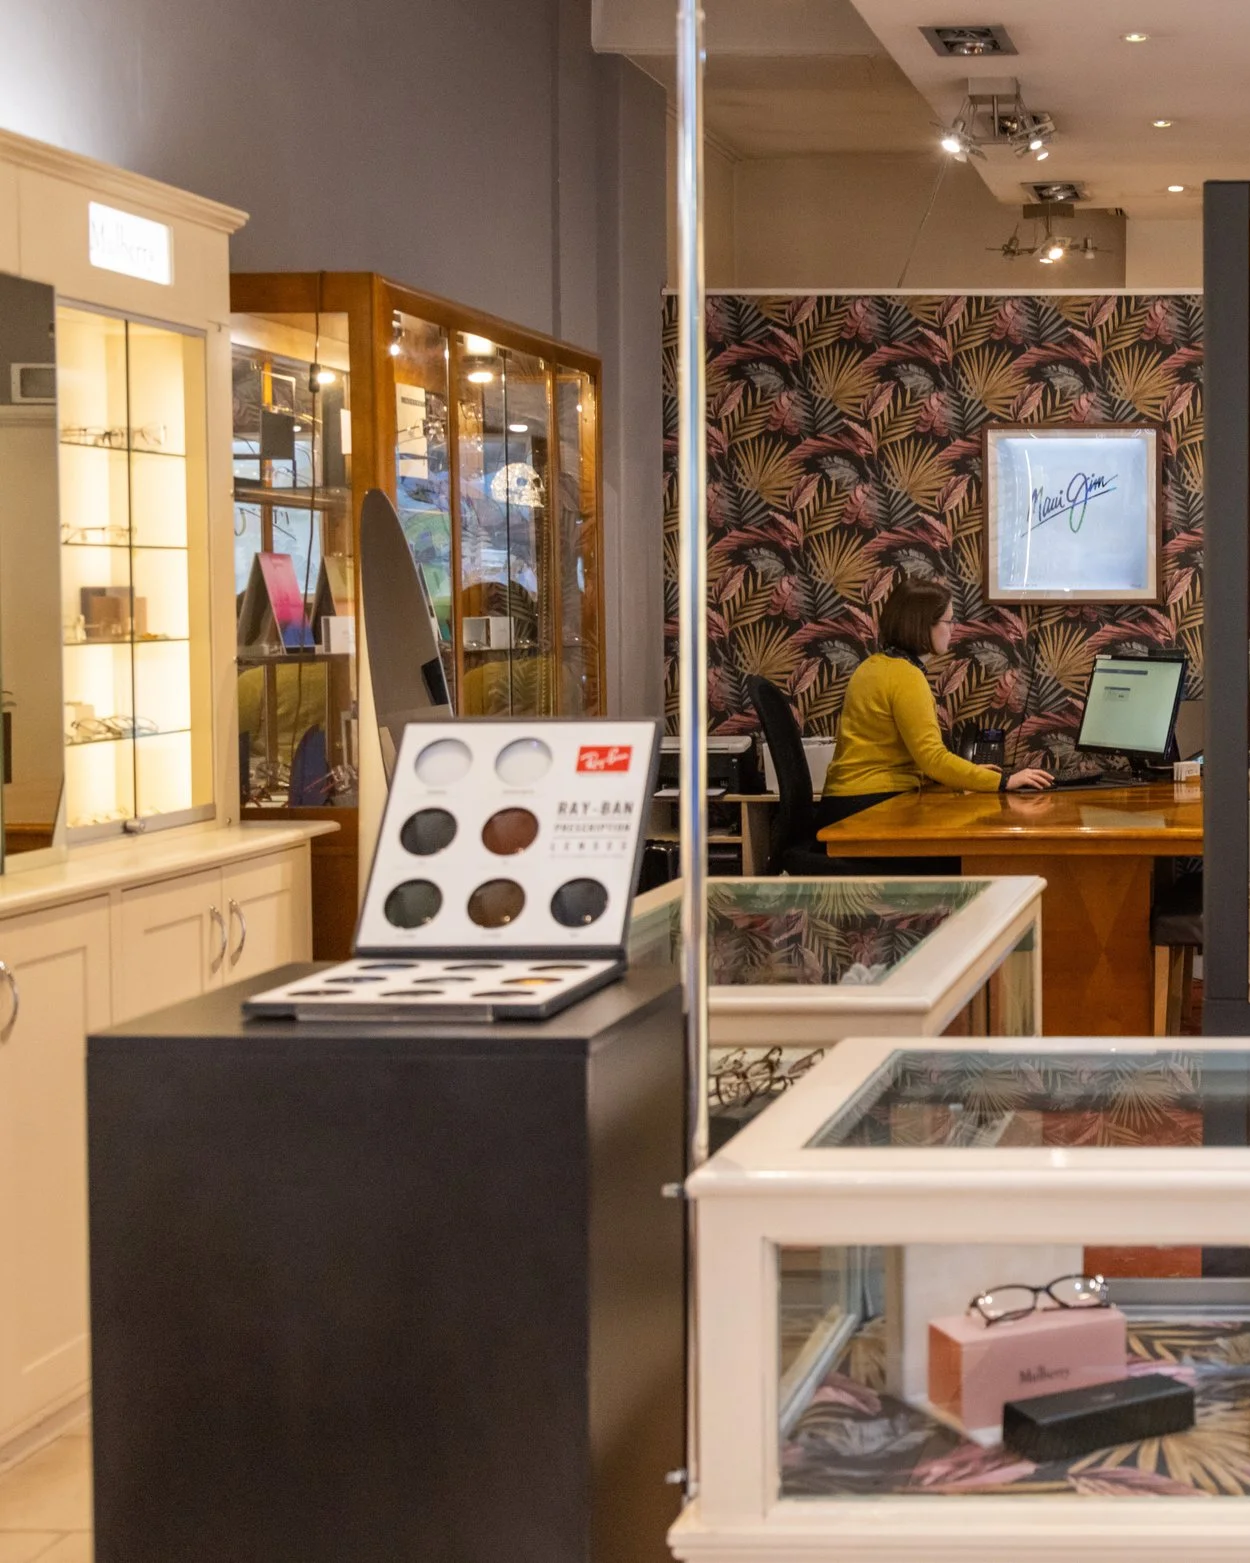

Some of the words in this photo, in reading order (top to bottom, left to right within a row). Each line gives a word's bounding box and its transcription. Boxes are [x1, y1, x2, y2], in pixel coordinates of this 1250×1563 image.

[1027, 485, 1066, 524] Maui
[1066, 472, 1119, 534] Jim
[558, 801, 634, 815] RAY-BAN
[1019, 1365, 1070, 1383] Mulberry
